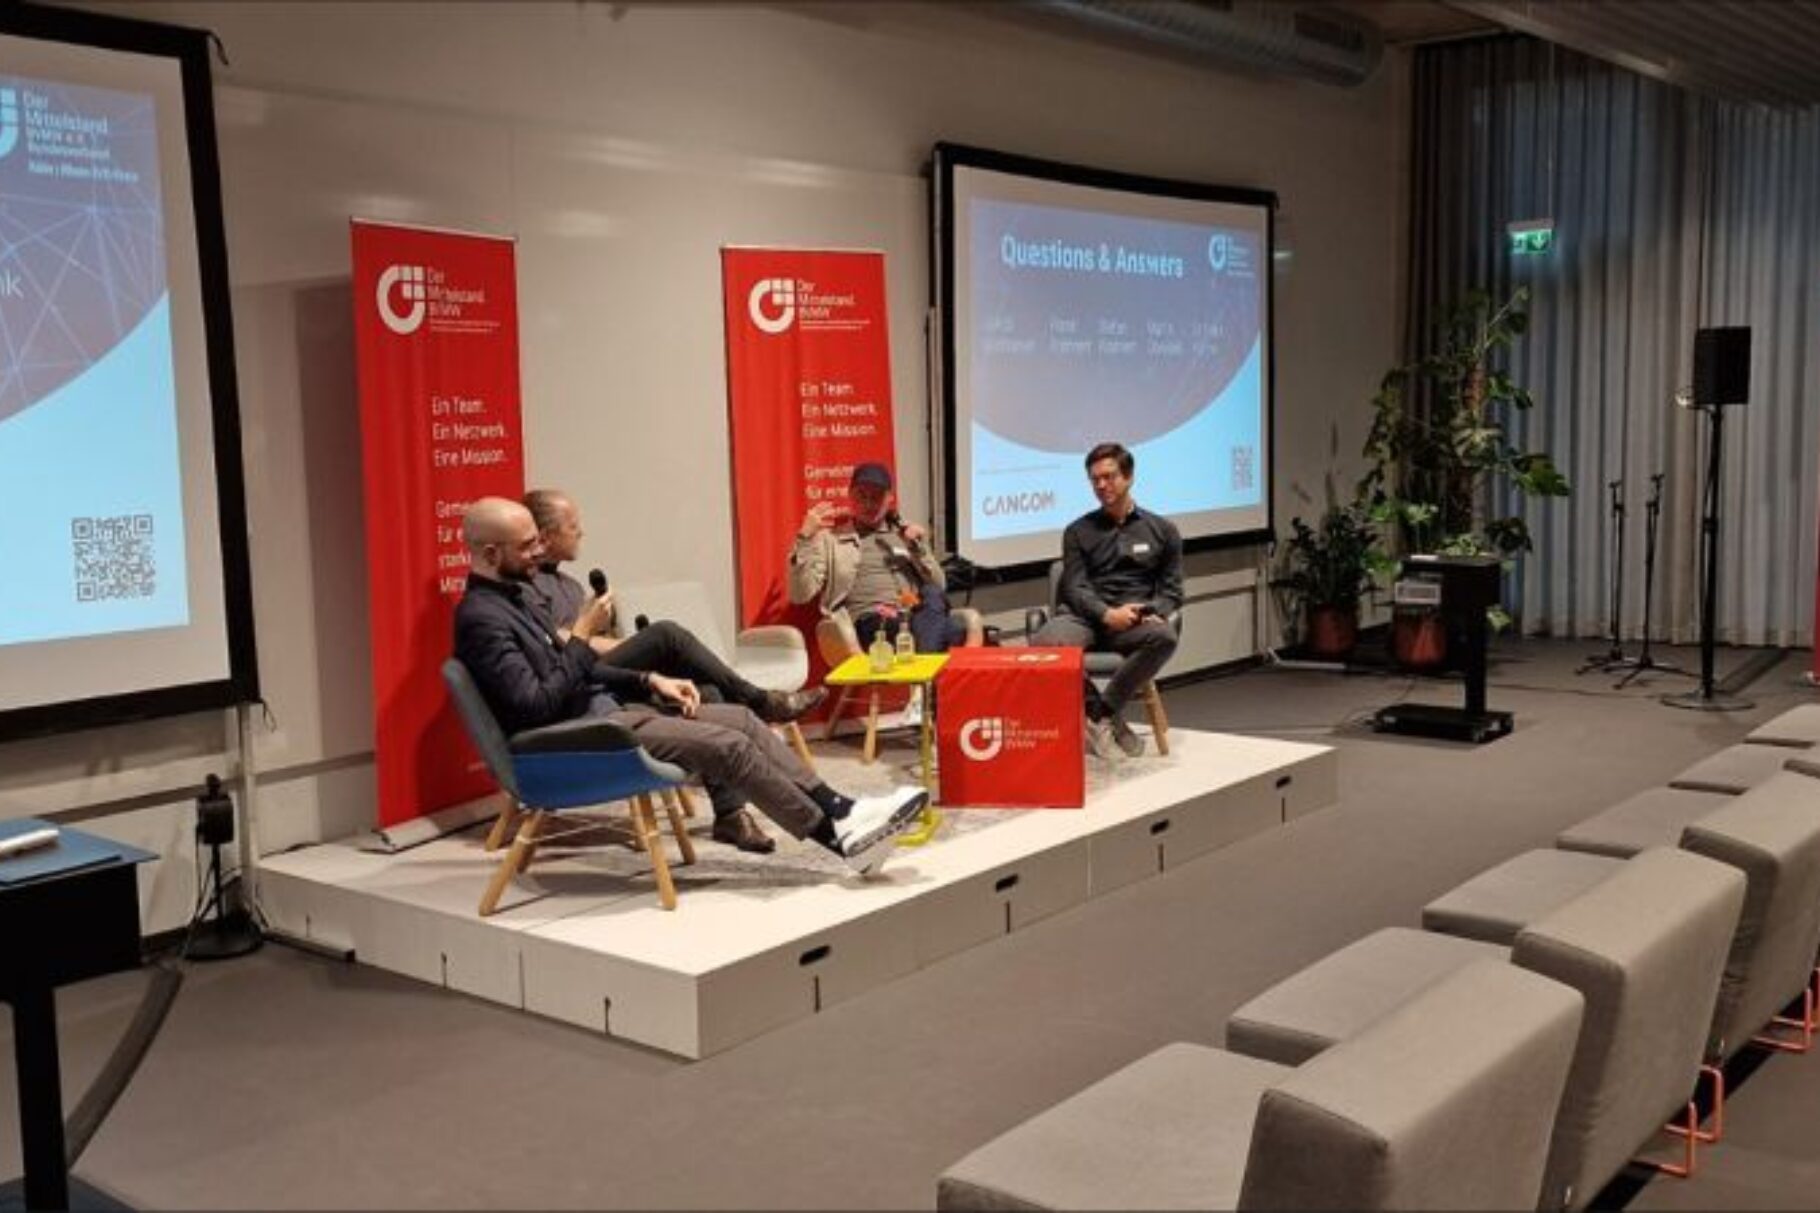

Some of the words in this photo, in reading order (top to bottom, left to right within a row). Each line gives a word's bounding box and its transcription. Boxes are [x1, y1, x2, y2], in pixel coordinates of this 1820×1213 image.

[1001, 234, 1094, 272] Questions
[1099, 245, 1111, 272] &
[1115, 248, 1184, 279] Answers
[801, 382, 819, 397] Ein
[433, 397, 450, 416] Ein
[801, 403, 820, 417] Ein
[433, 422, 450, 441] Ein
[802, 423, 828, 438] Eine
[435, 449, 459, 467] Eine
